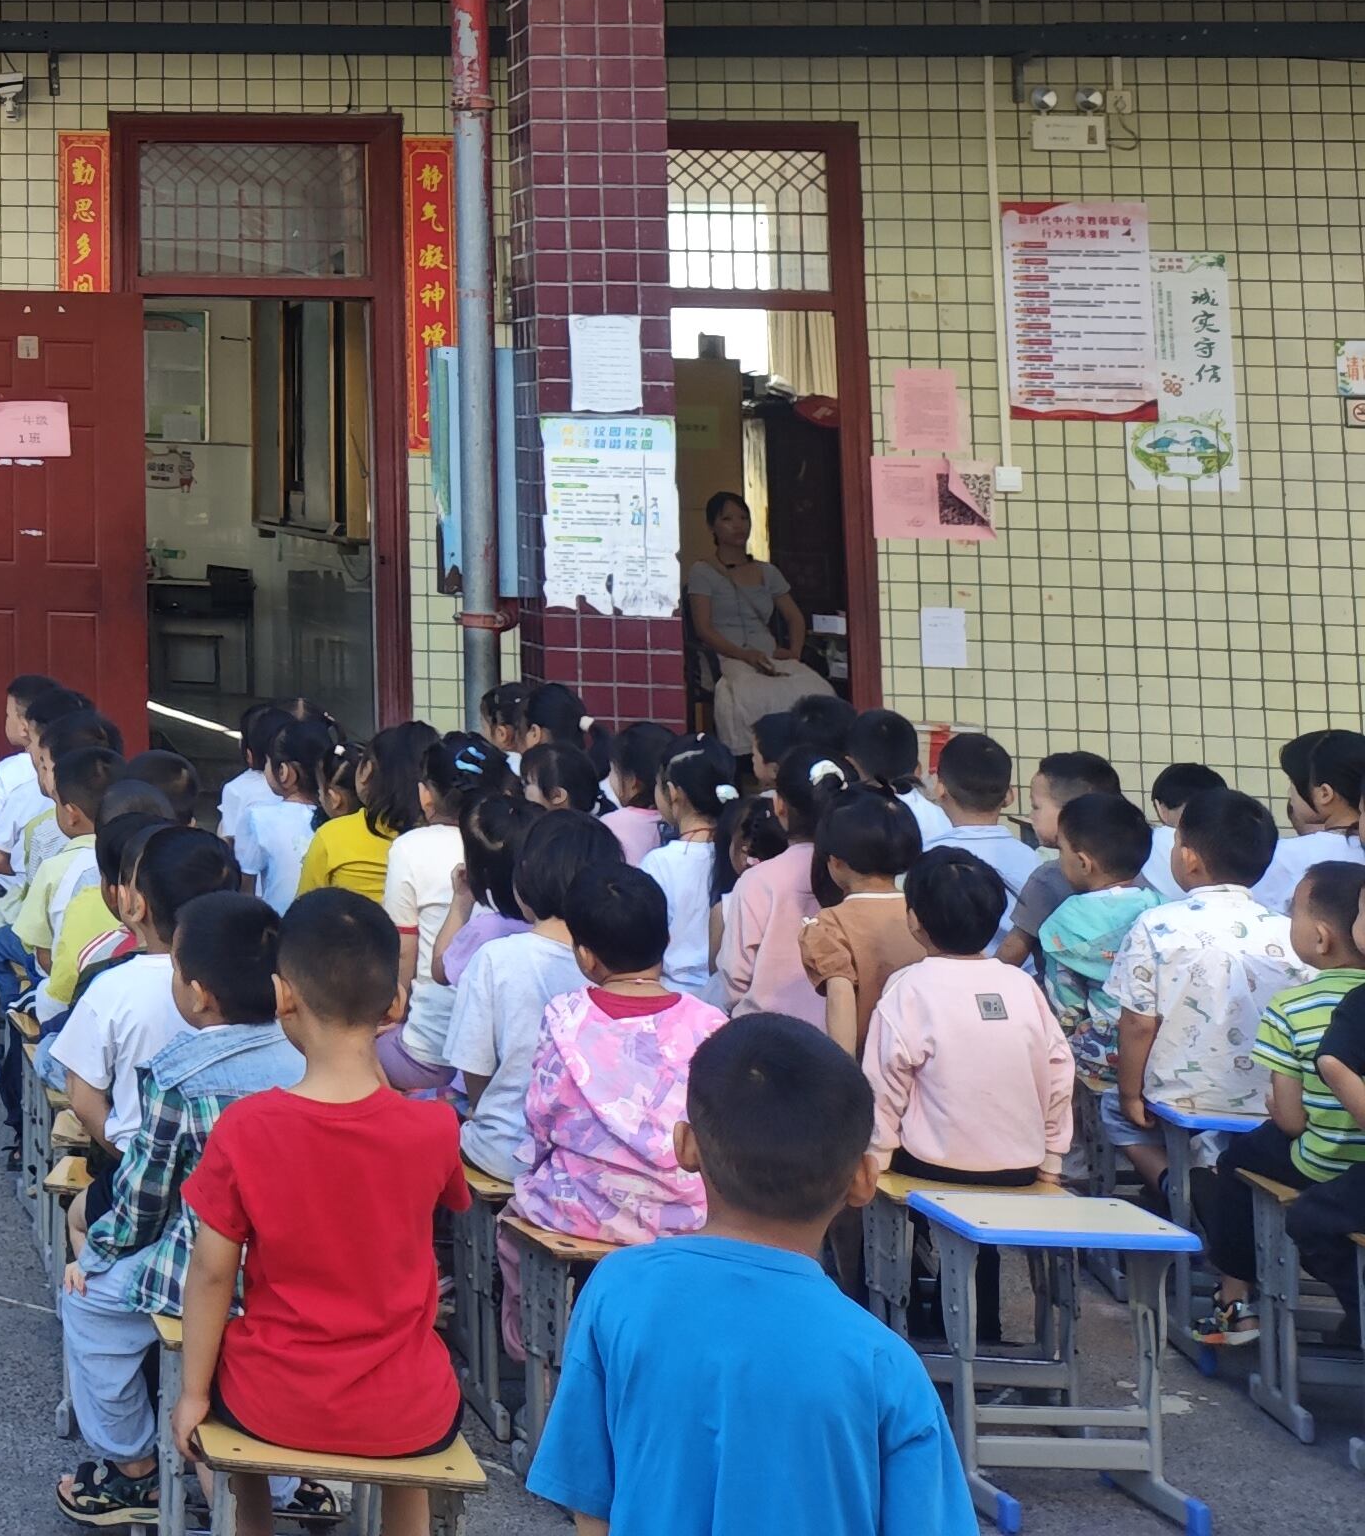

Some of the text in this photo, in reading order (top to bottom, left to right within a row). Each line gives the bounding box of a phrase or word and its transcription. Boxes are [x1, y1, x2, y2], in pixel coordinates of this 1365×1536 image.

[72, 156, 95, 292] 勤思多问
[417, 164, 449, 429] 静气凝神增
[1191, 288, 1221, 383] 诚实守信
